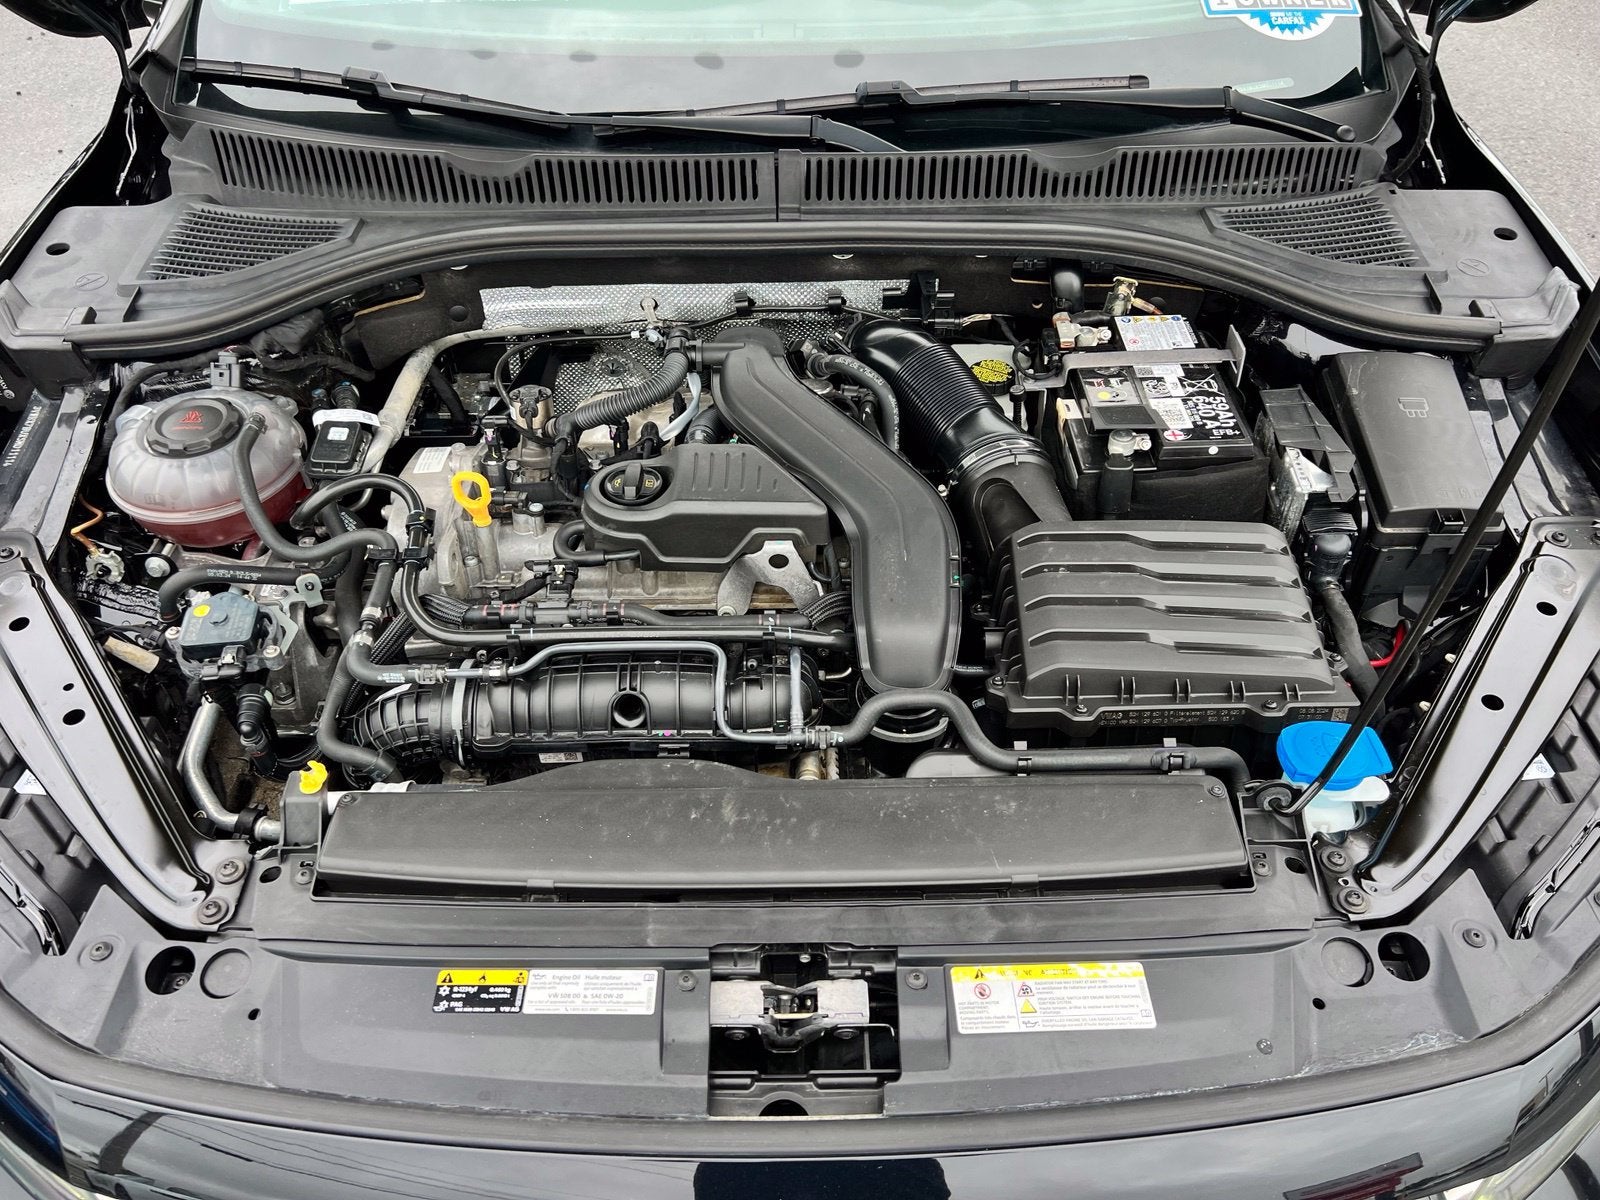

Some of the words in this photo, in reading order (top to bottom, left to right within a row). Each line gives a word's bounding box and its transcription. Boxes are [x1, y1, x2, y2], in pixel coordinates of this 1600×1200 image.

[1271, 16, 1305, 25] CARFAX
[1192, 396, 1216, 418] 640
[1208, 396, 1238, 427] 59Ah
[1212, 428, 1241, 436] EFB+
